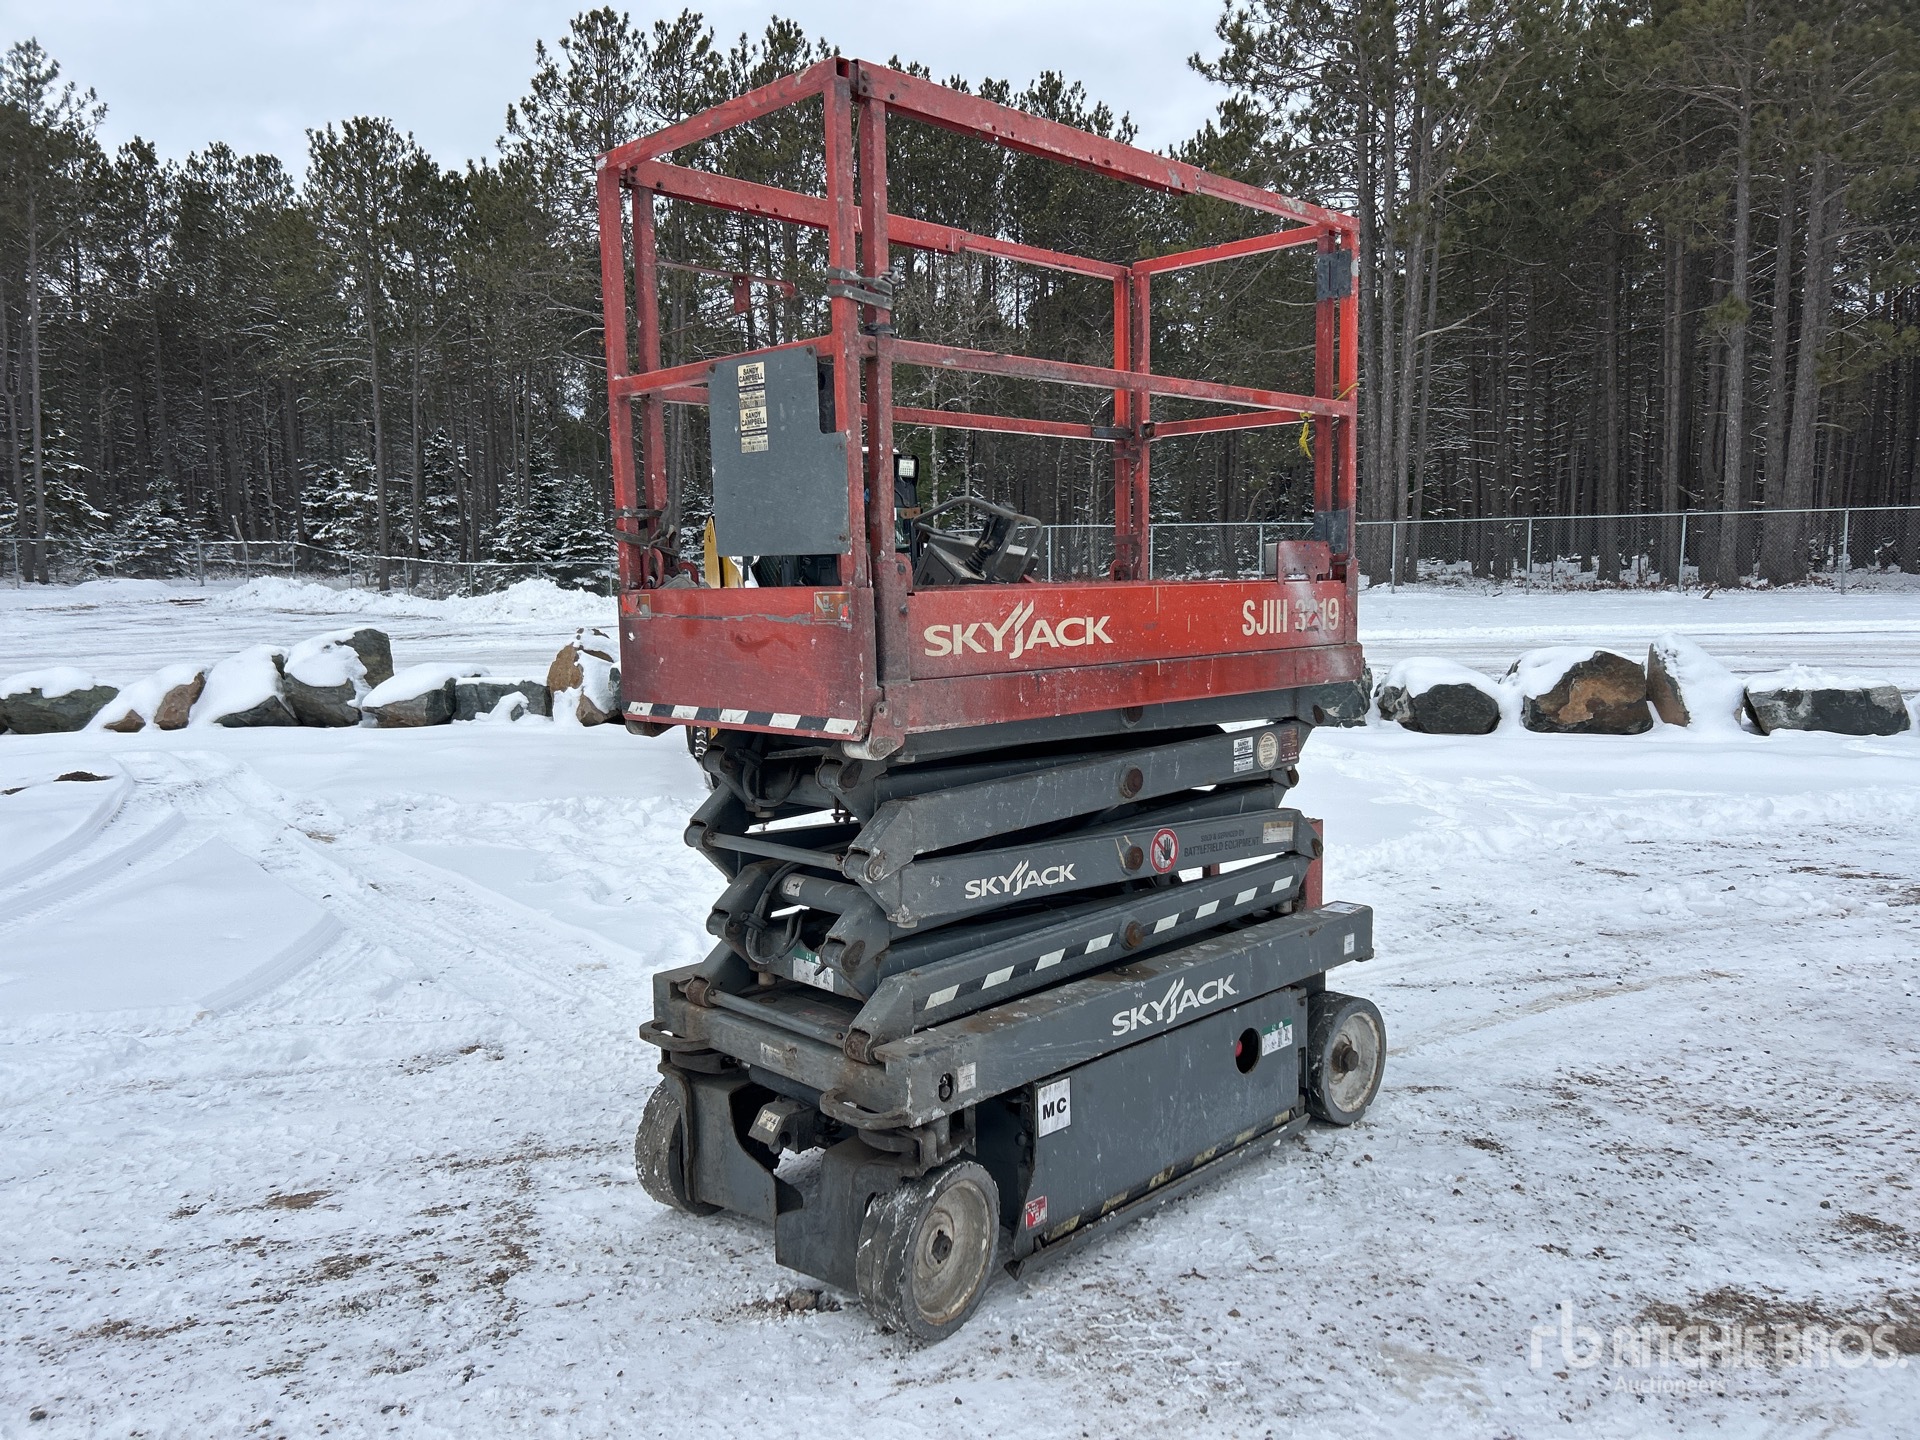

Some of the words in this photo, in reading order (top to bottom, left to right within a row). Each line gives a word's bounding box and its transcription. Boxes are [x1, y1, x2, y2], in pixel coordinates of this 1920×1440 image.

[739, 373, 763, 383] CAMPBELL
[743, 367, 759, 375] SANDY
[741, 417, 766, 427] CAMPBELL
[745, 411, 761, 419] SANDY
[1242, 599, 1288, 636] SJIII
[923, 600, 1114, 660] SKYJACK
[1184, 841, 1224, 857] BATTLEFIELD
[1224, 836, 1259, 851] EQUIPMENT
[964, 859, 1077, 900] SKYJACK
[1111, 973, 1237, 1036] SKYJACK
[1042, 1097, 1067, 1120] MC
